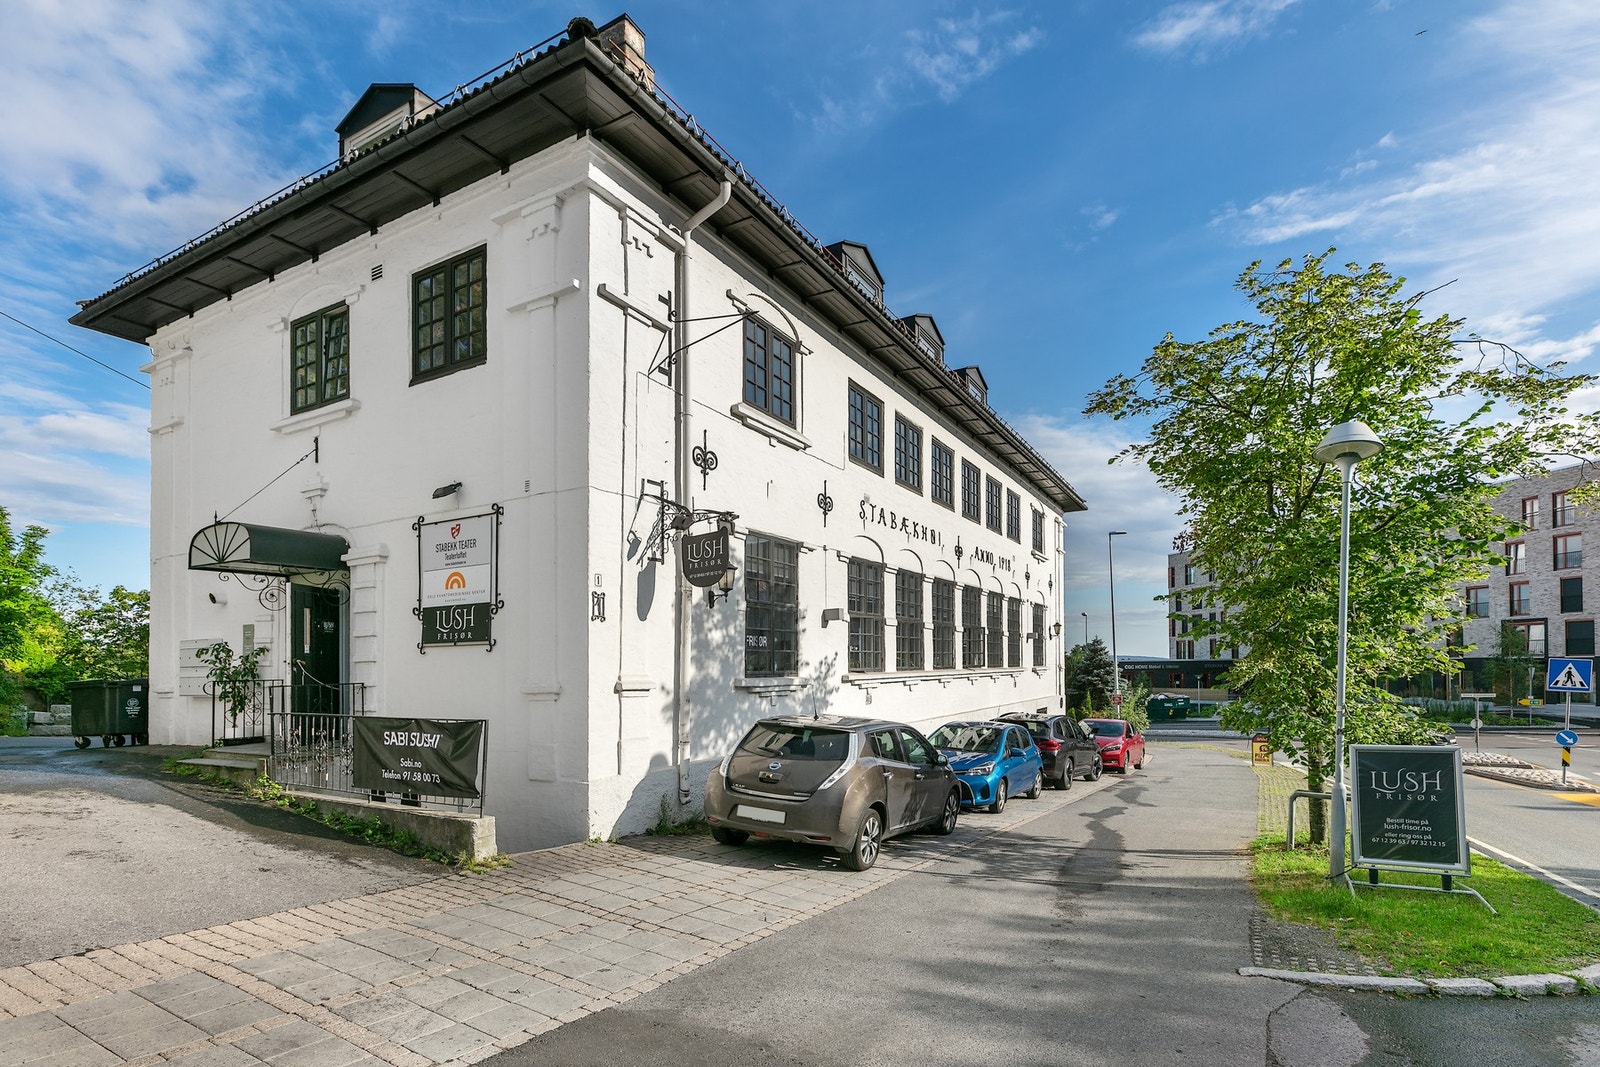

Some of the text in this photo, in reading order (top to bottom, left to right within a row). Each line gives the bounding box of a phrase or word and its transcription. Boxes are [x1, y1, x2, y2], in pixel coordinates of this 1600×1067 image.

[435, 538, 477, 553] STABEKK TEATER
[687, 536, 724, 562] LUSH
[974, 546, 993, 565] ANNO
[436, 605, 475, 633] LUSH
[437, 631, 473, 640] FRISØR
[384, 731, 440, 748] SABI SUSHI
[400, 758, 421, 769] Sabi.no
[382, 769, 440, 783] Telefon 91 58 00 73
[1370, 768, 1442, 793] LUSH
[1376, 792, 1438, 801] FRISØR
[1384, 823, 1432, 832] lush-frisor.no
